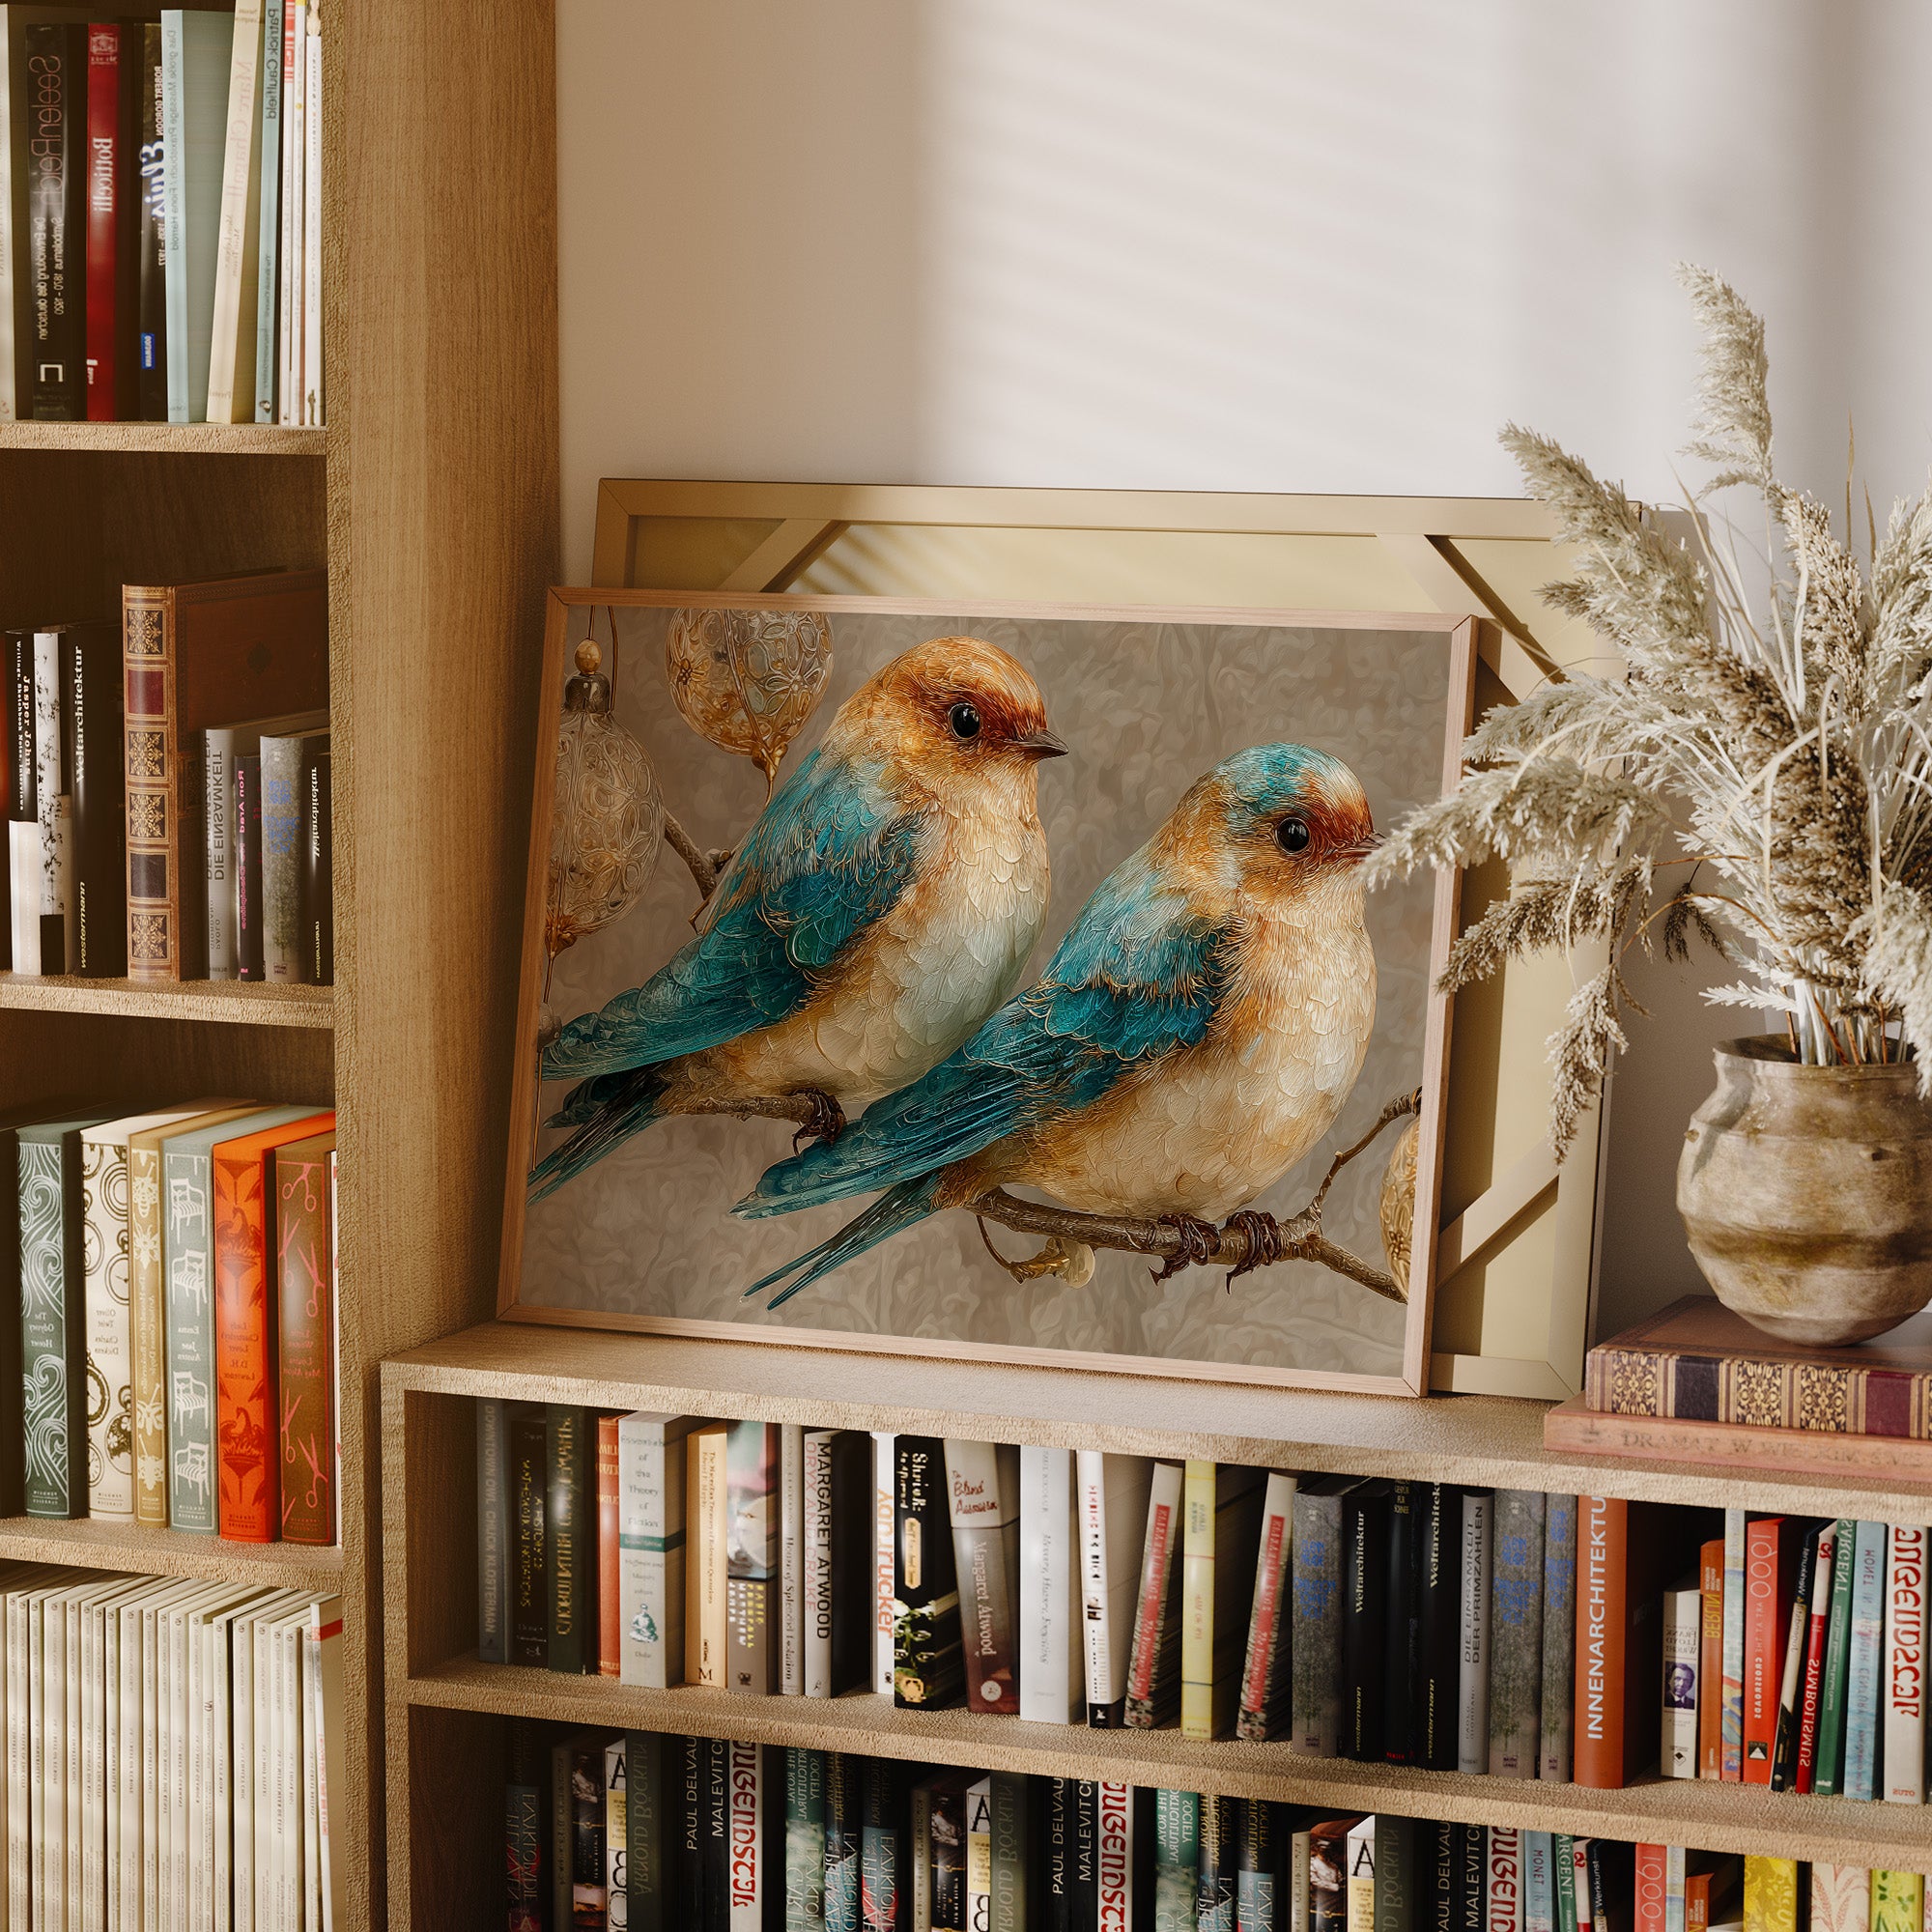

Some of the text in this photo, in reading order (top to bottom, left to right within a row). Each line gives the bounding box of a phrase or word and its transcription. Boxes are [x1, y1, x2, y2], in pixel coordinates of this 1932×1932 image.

[23, 731, 32, 776] Johns
[74, 645, 85, 784] Weltarchitektur
[485, 1406, 497, 1633] DOWNTOWN OWL CHUCK KLOSTERMAN
[628, 1517, 659, 1529] Fiction
[629, 1484, 659, 1497] Theory
[805, 1441, 817, 1612] ORYX AND CRAKE
[817, 1442, 831, 1639] MARGARET ATWOOD
[1354, 1511, 1365, 1614] Weltarchitektur
[1464, 1520, 1474, 1629] EINSAMKEIT
[1472, 1506, 1483, 1664] DER PRIMZAHLEN
[972, 1540, 997, 1656] Margaret Atwood
[1587, 1496, 1606, 1740] INNENARCHITEKTU
[1427, 1678, 1435, 1759] westermann
[686, 1737, 697, 1851] PAUL DELVAU
[1052, 1777, 1065, 1894] PAUL DELVAU
[1352, 1839, 1375, 1877] A
[1438, 1821, 1451, 1890] DELVAU
[1532, 1849, 1546, 1902] MONET IN
[1558, 1834, 1574, 1898] ARGENT
[1573, 1851, 1586, 1868] 2
[1593, 1861, 1605, 1908] Werkkunst
[1635, 1856, 1662, 1919] 1900
